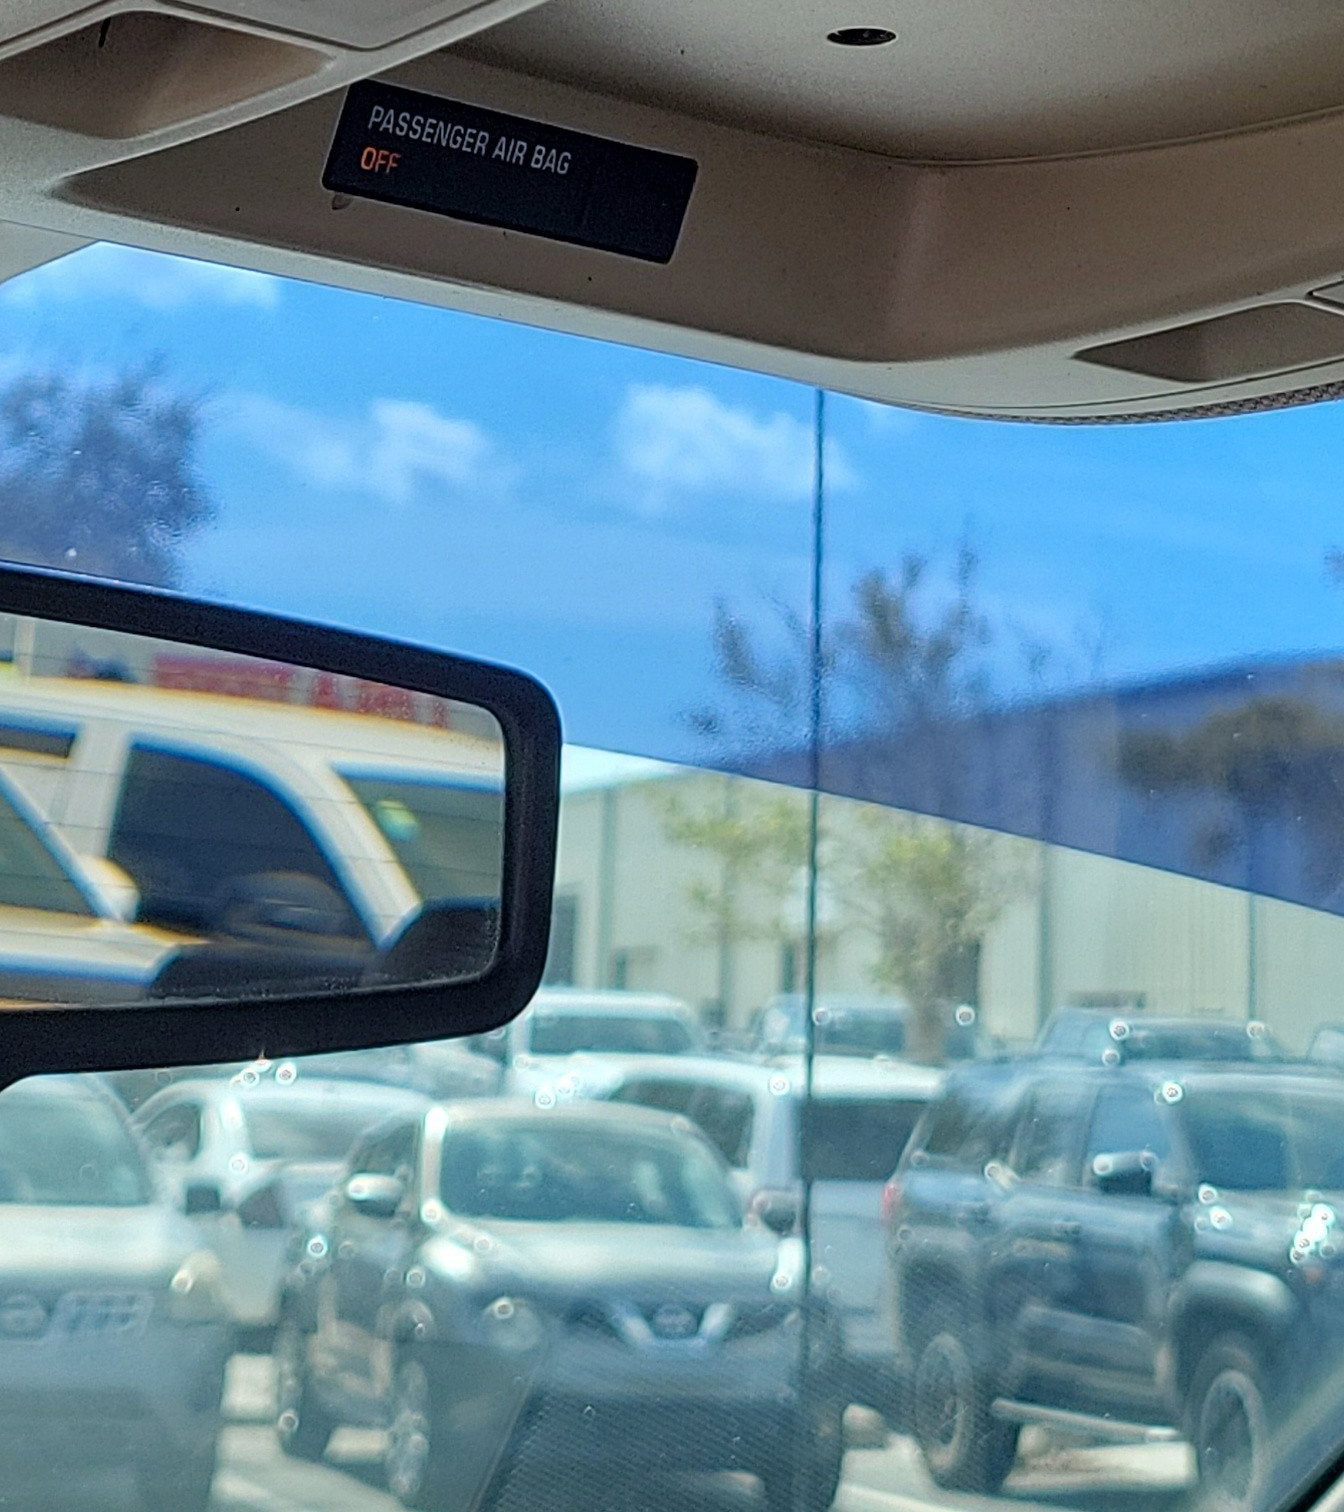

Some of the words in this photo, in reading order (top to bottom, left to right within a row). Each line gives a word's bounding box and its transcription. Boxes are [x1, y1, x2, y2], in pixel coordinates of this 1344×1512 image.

[360, 146, 401, 173] OFF
[367, 105, 490, 156] PASSENGER
[493, 135, 528, 167] AIR
[530, 144, 573, 176] BAG
